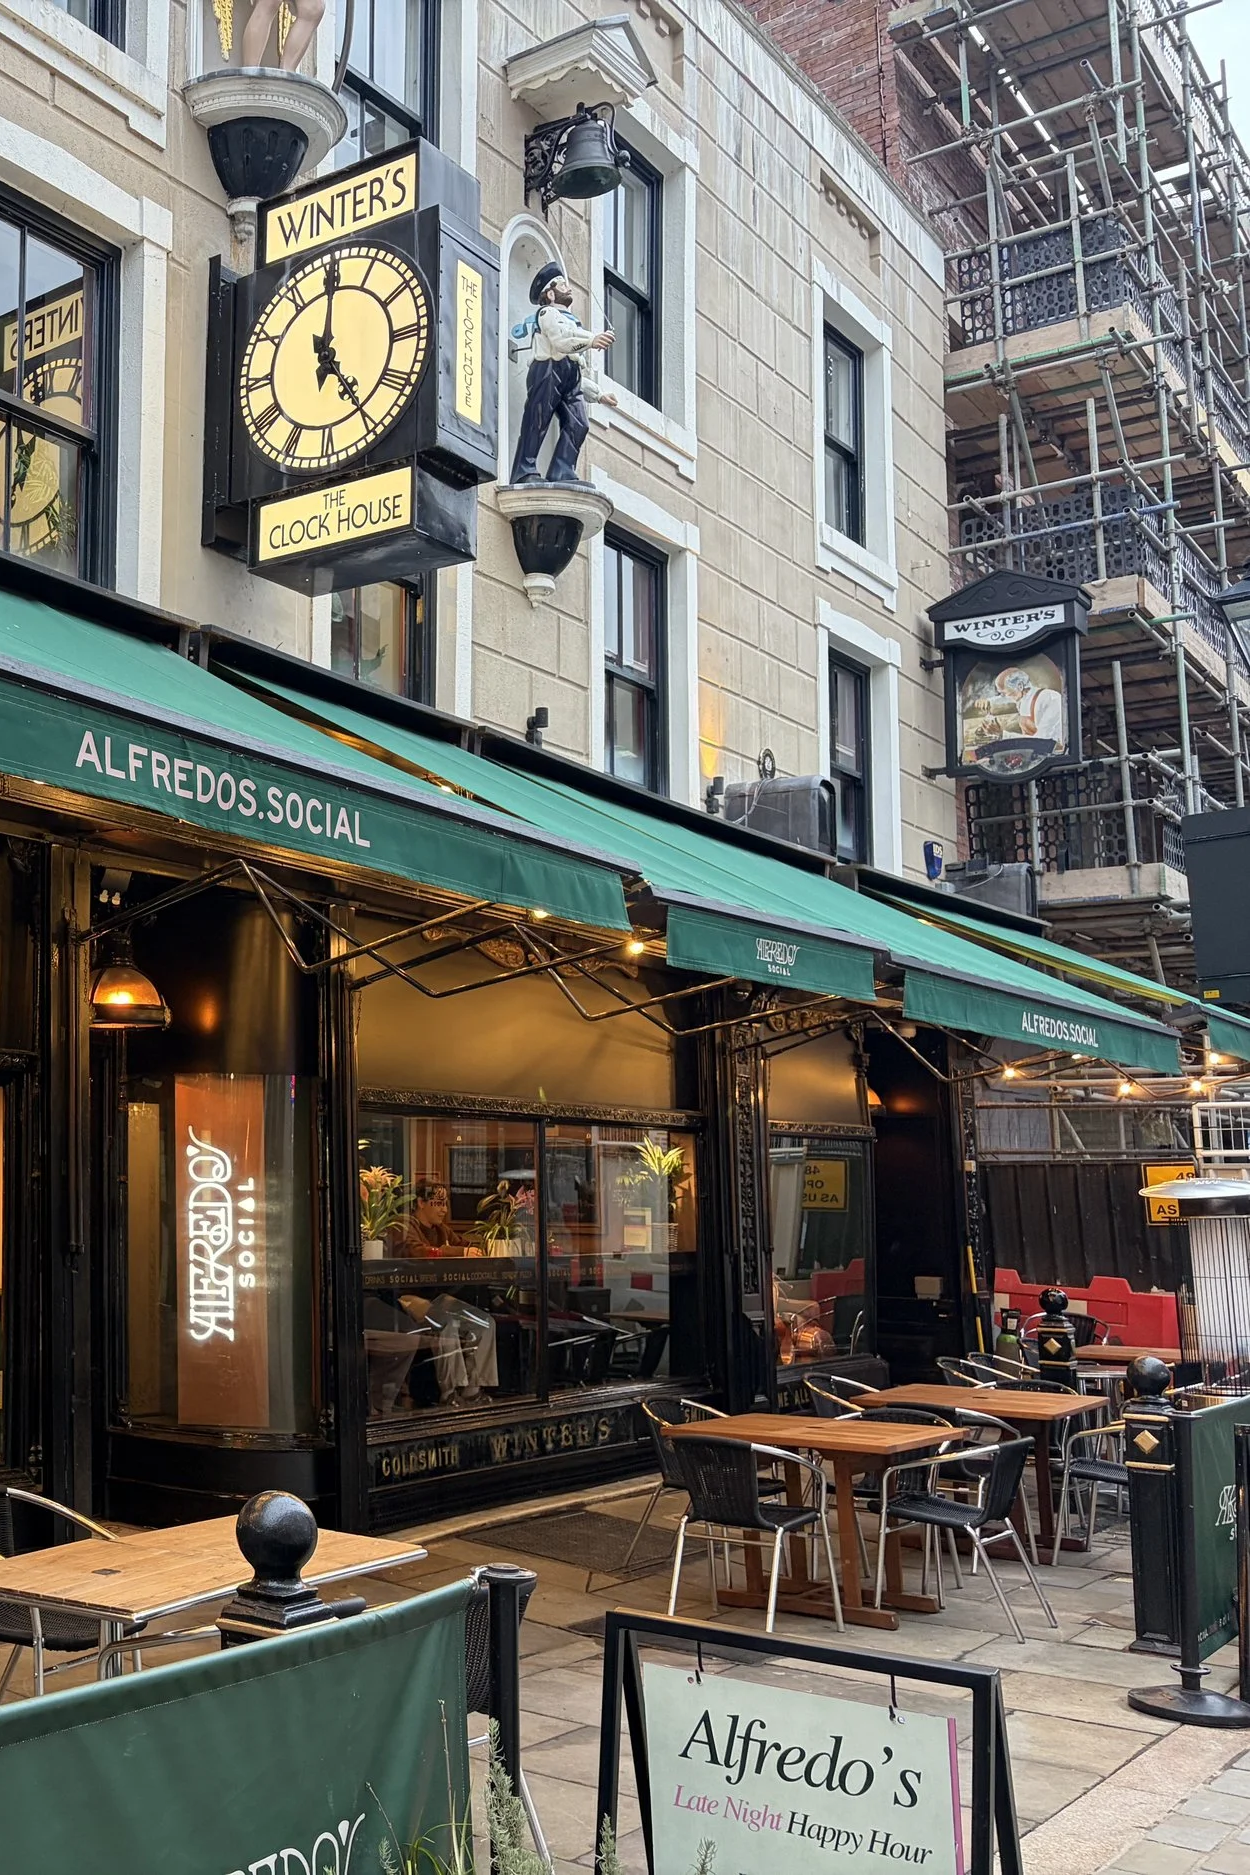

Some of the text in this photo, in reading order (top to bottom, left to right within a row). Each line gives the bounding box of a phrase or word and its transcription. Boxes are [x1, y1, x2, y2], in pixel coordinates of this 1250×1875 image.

[277, 167, 407, 249] WINTER'S
[461, 275, 478, 408] THE CLOCK HOUSE
[269, 493, 403, 550] CLOCK HOUSE
[323, 489, 347, 510] THE
[953, 609, 1056, 634] WINTER'S
[75, 730, 371, 848] ALFREDOS.SOCIAL
[767, 964, 791, 977] SOCIAL
[1021, 1011, 1099, 1048] ALFREDOS.SOCIAL
[237, 1177, 256, 1289] SOCIAL
[1157, 1204, 1178, 1216] AS
[389, 1274, 419, 1285] SOCIAL
[443, 1271, 471, 1282] SOCIAL
[678, 1709, 922, 1808] Alfredo's
[674, 1784, 934, 1865] Late Night Happy Hour
